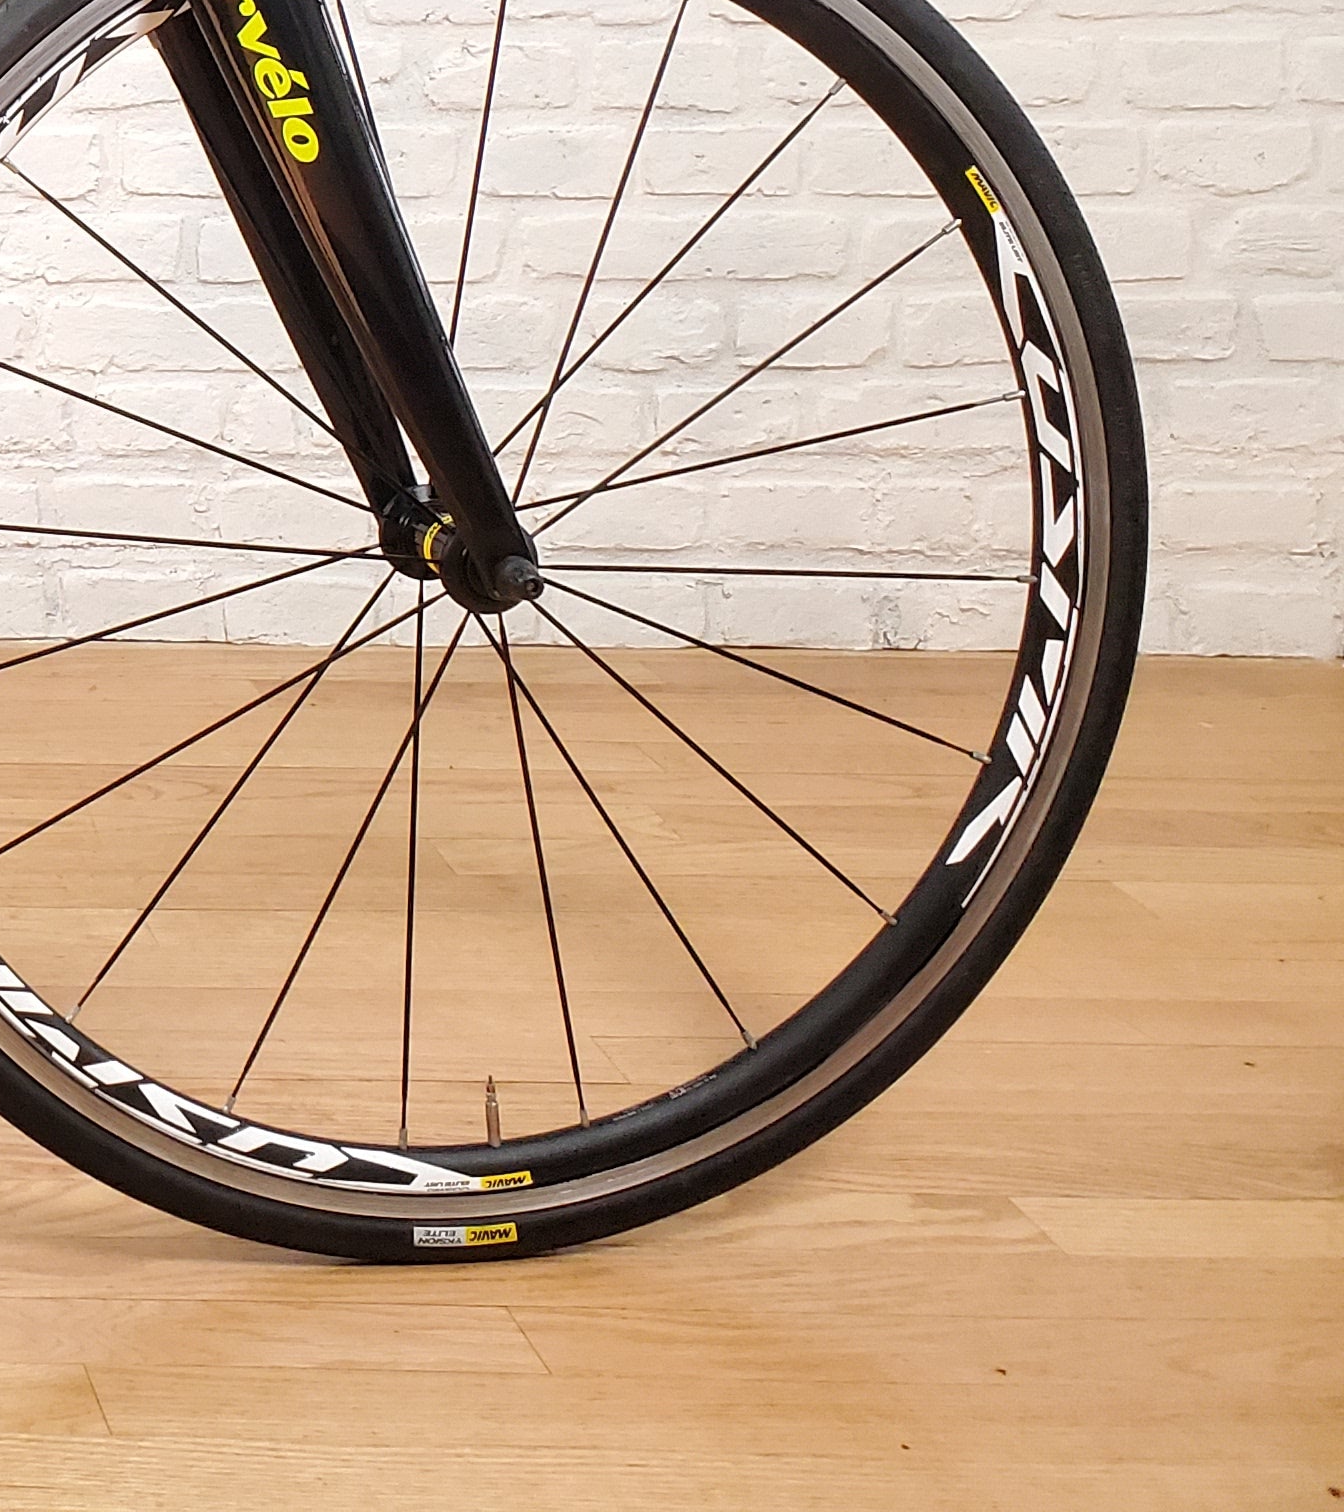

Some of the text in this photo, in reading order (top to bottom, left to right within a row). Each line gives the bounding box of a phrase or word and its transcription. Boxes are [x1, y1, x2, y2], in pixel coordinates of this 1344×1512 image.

[971, 172, 1000, 212] MAVIC
[484, 1174, 527, 1189] MAVIC
[423, 1229, 457, 1237] ELITE
[469, 1227, 513, 1243] MAVIC
